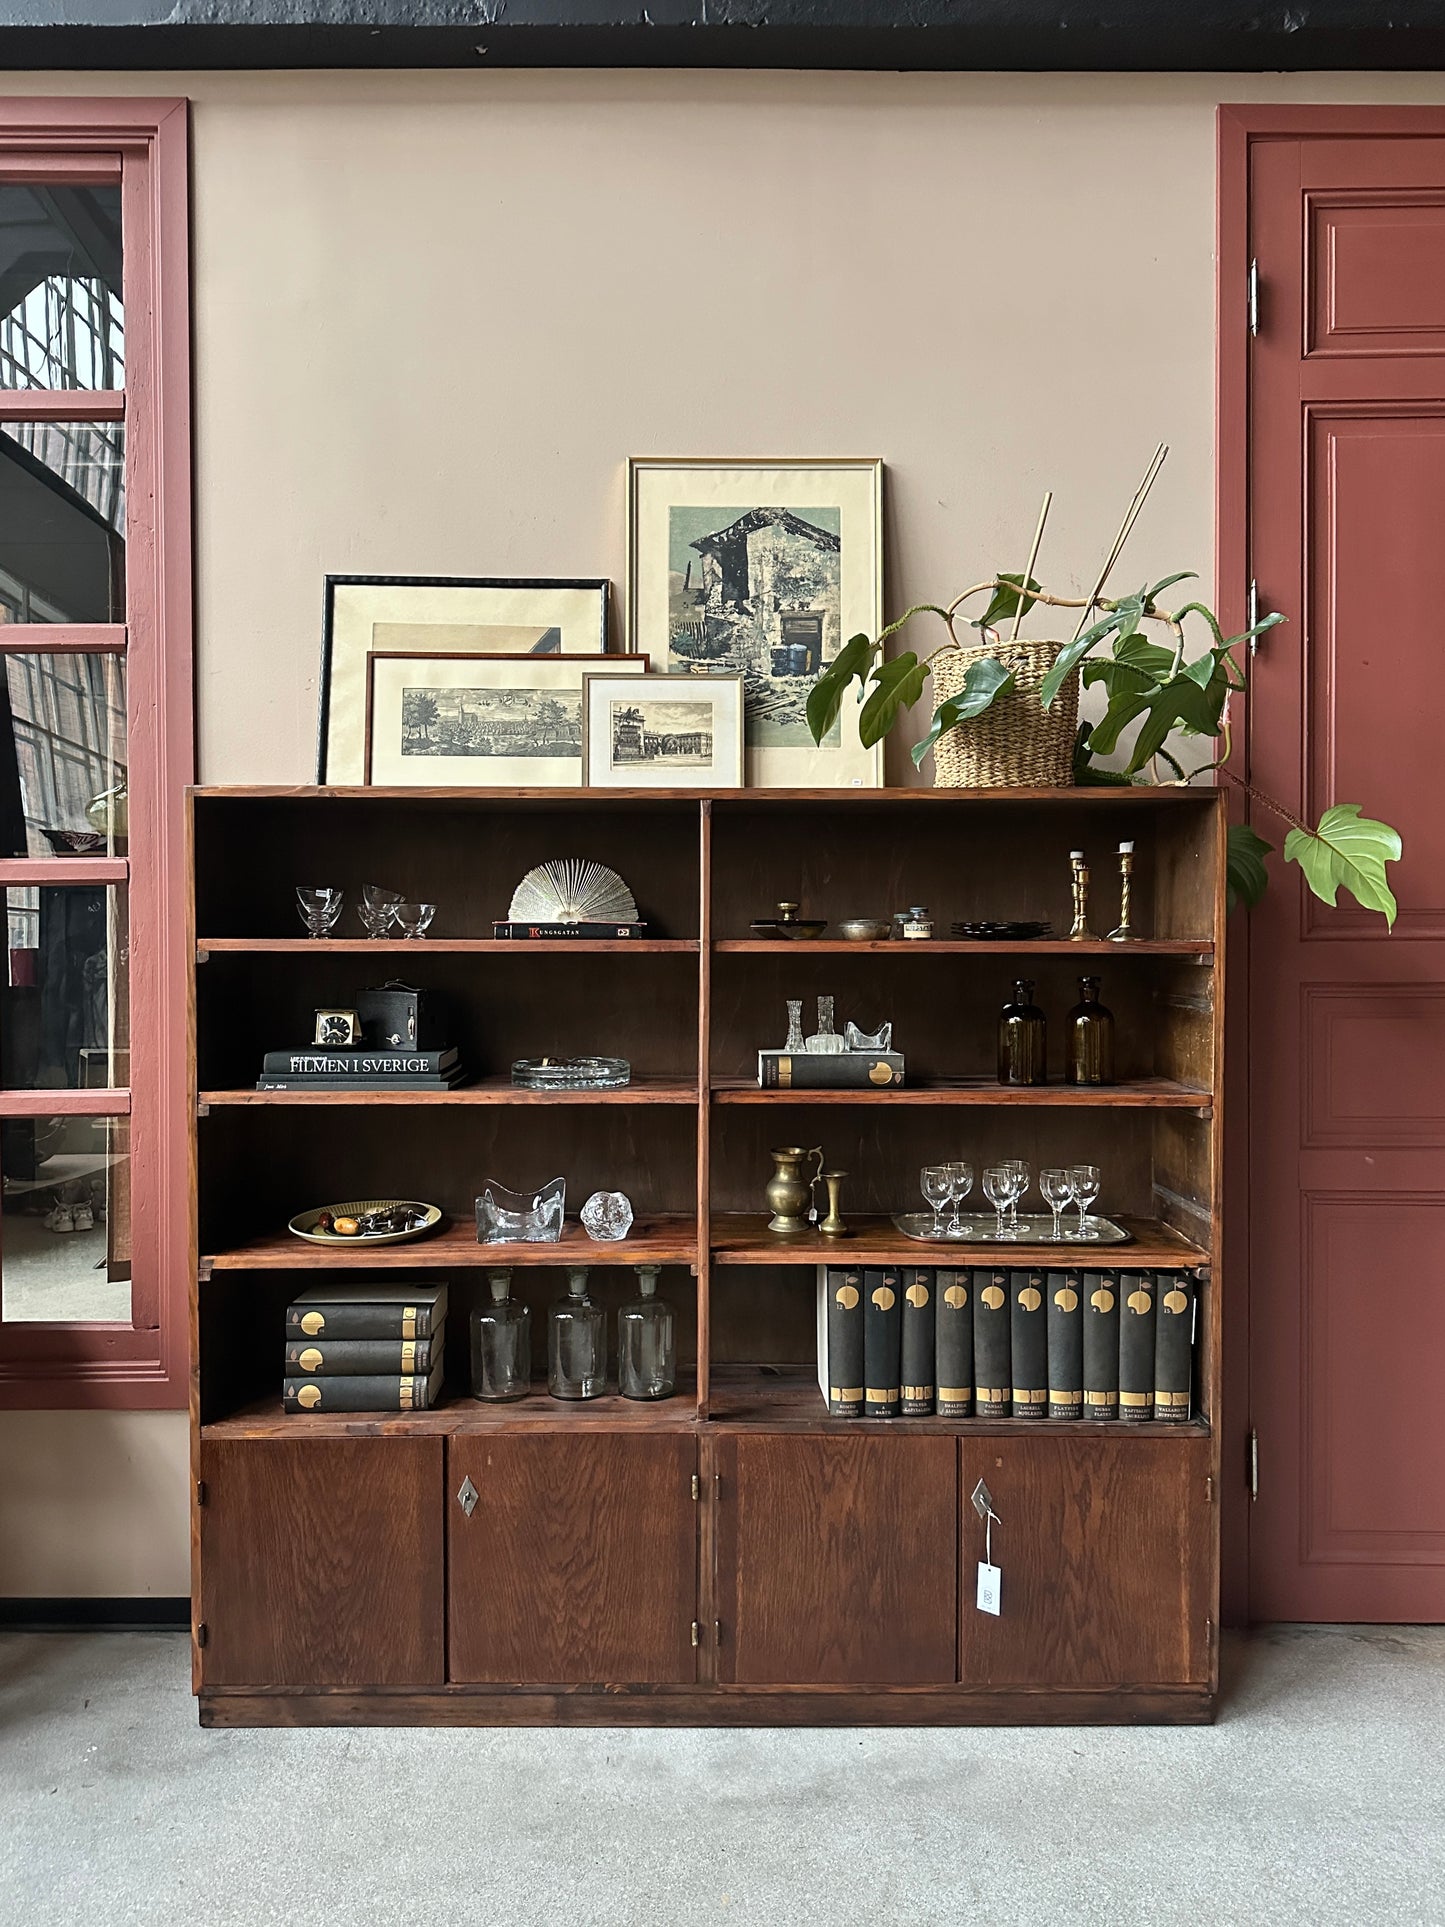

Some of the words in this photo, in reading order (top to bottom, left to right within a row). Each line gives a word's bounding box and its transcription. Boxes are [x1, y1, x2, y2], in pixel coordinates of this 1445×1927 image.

[528, 928, 580, 938] KUNGSGATAN
[290, 1059, 350, 1072] FILMEN
[354, 1060, 360, 1072] I
[362, 1059, 429, 1072] SVERIGE
